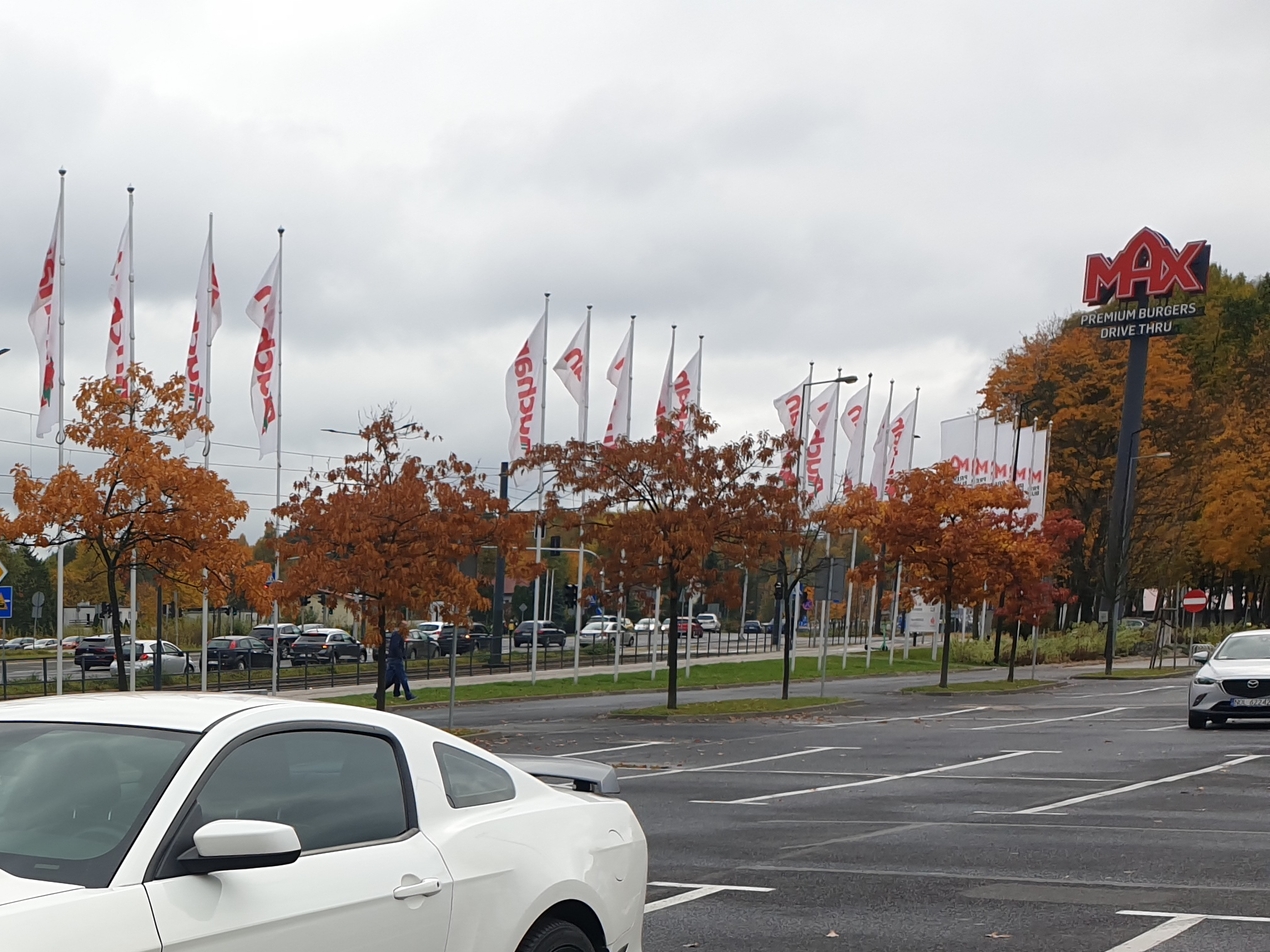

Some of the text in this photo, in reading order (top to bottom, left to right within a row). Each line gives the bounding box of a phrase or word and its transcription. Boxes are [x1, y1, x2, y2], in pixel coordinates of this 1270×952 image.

[1082, 226, 1208, 304] MAX
[1080, 302, 1197, 326] PREMIUM BURGERS
[1100, 320, 1173, 339] DRIVE THRU
